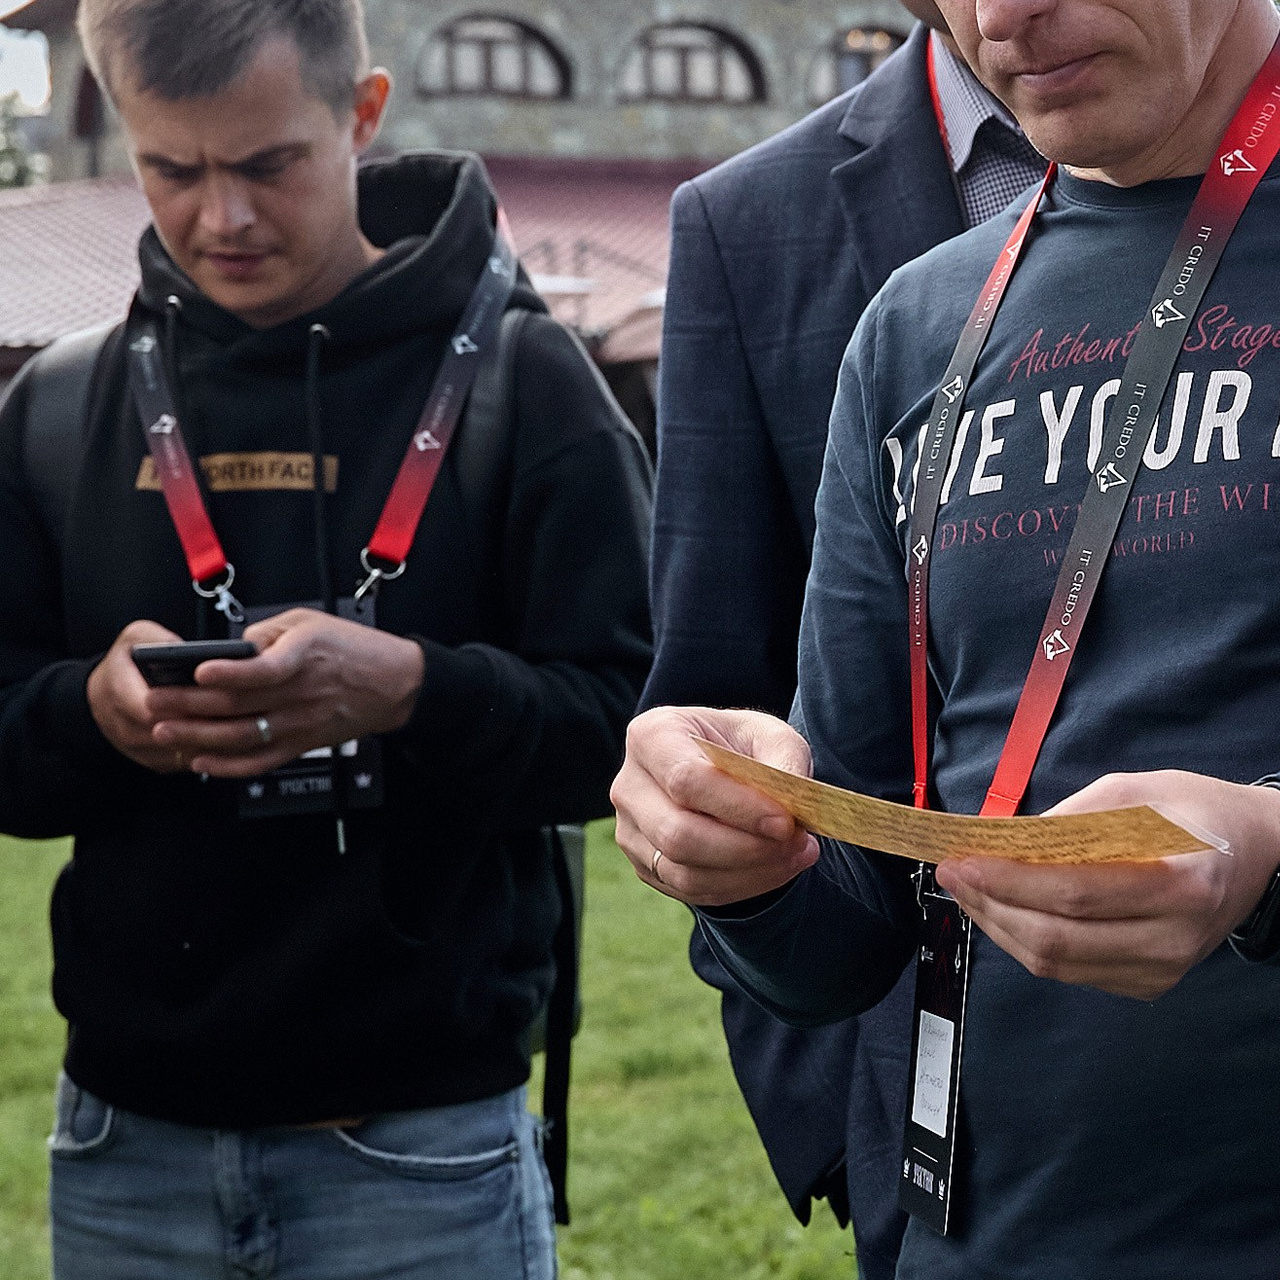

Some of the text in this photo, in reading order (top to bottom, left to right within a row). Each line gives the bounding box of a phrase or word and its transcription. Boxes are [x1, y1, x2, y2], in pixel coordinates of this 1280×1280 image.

[1245, 103, 1277, 148] CREDO
[1173, 226, 1212, 297] IT CREDO
[1008, 321, 1142, 382] Authent
[925, 408, 950, 480] IT CREDO
[1114, 383, 1148, 459] IT CREDO
[268, 460, 311, 480] FAC
[941, 504, 1082, 551] DISCOV
[1131, 488, 1200, 522] THE
[1061, 549, 1093, 626] IT CREDO
